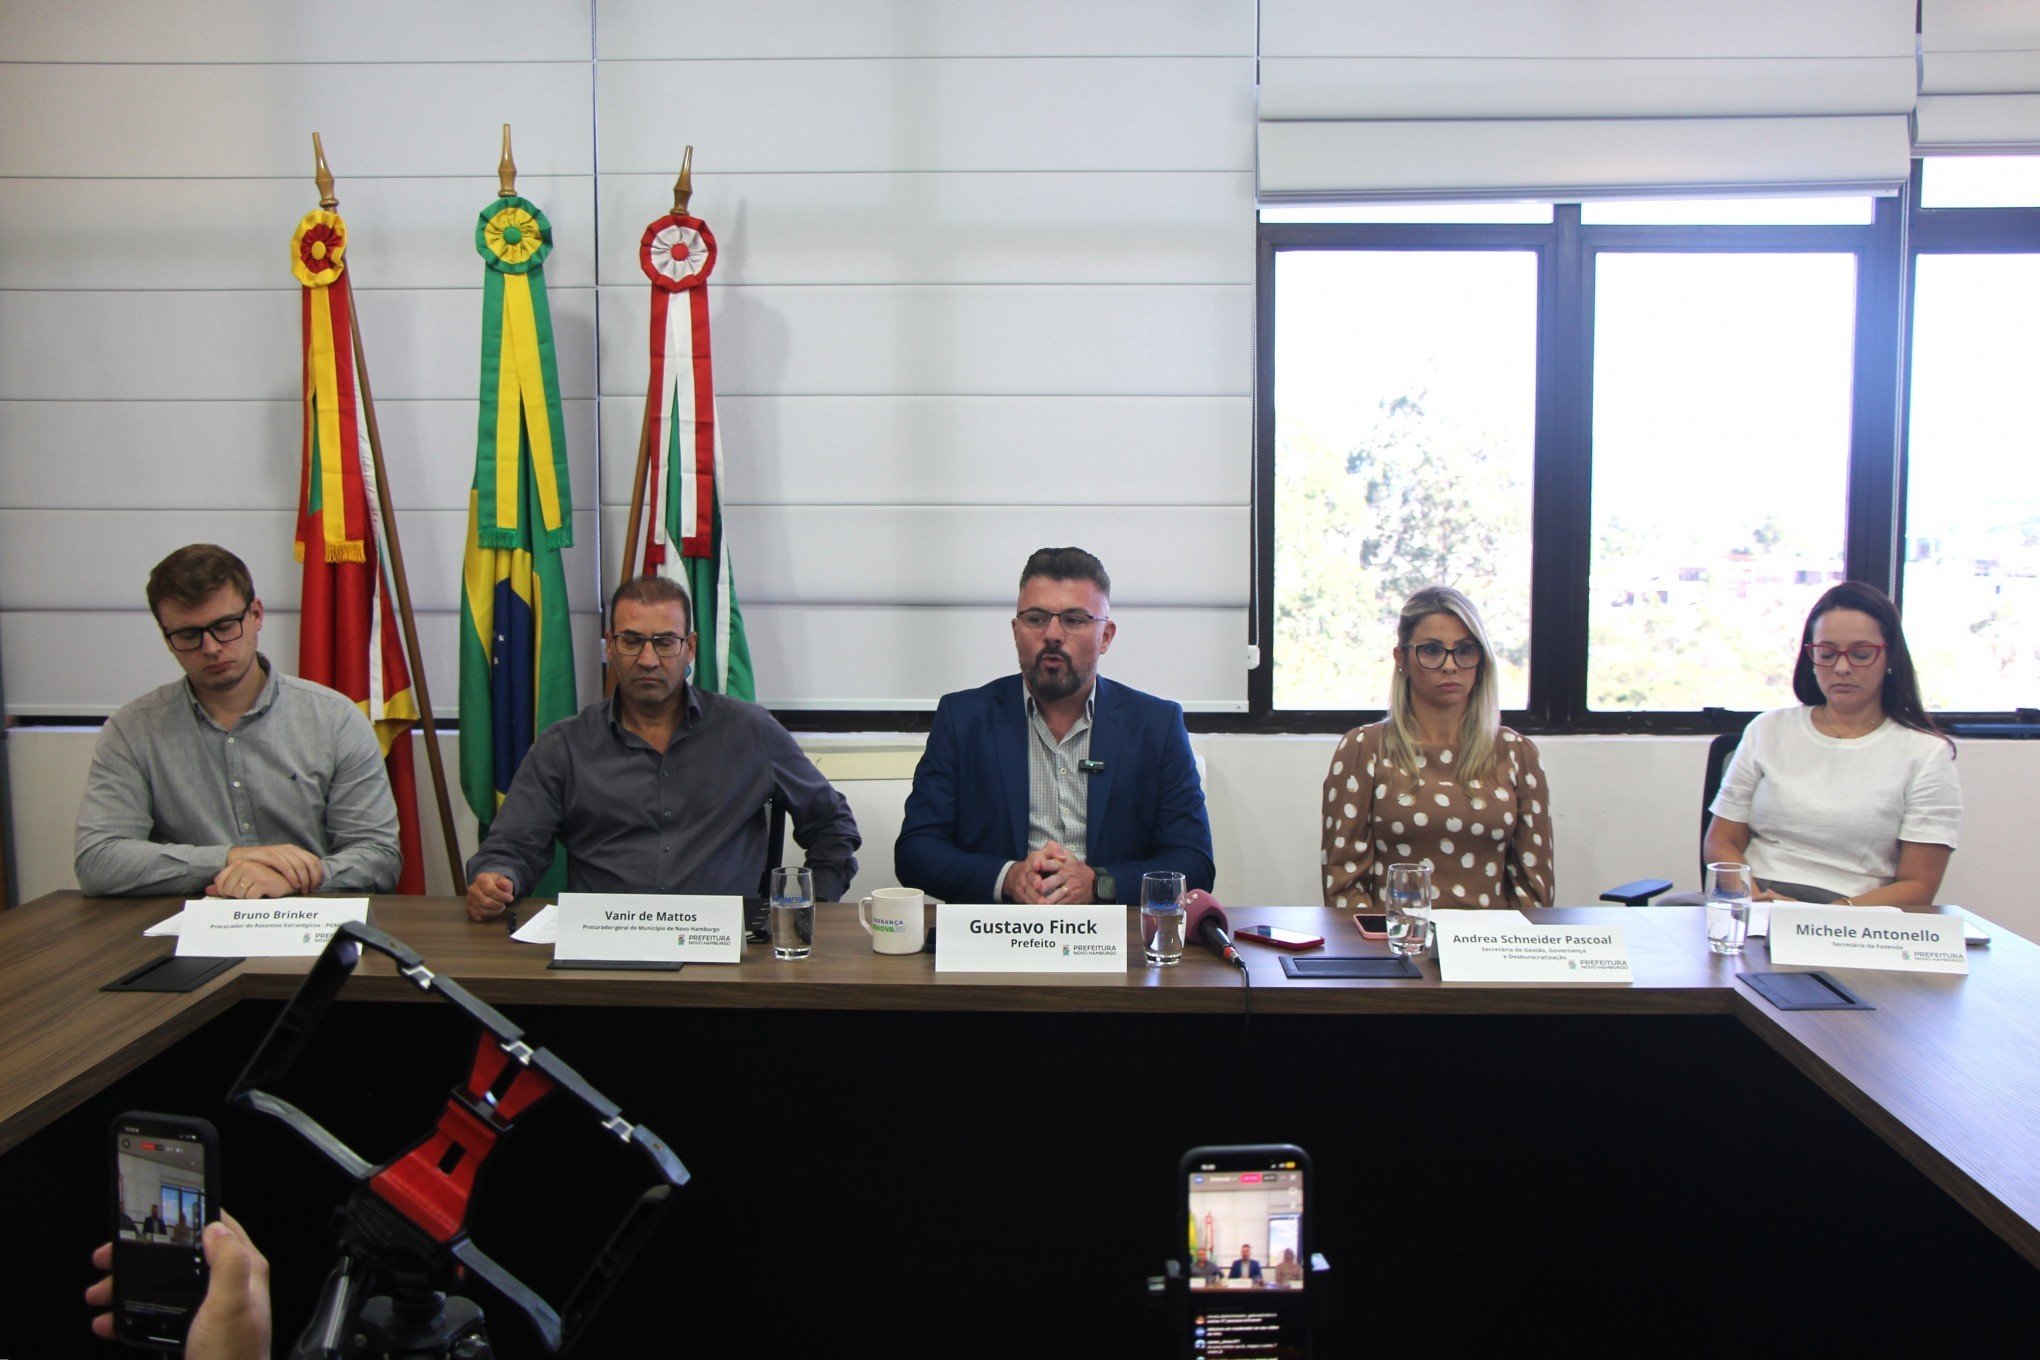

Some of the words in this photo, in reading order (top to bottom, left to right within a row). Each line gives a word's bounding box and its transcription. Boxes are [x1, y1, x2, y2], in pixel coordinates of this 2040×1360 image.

[233, 910, 270, 920] Bruno
[273, 910, 319, 920] Brinker
[605, 910, 637, 920] Vanir
[639, 910, 654, 921] de
[656, 911, 698, 922] Mattos
[969, 919, 1044, 935] Gustavo
[1050, 919, 1098, 935] Finck
[688, 934, 731, 942] PREFEITURA
[1796, 923, 1857, 938] Michele
[1861, 927, 1940, 943] Antonello
[1010, 938, 1056, 949] Prefeito
[1452, 934, 1498, 944] Andrea
[1500, 934, 1562, 945] Schneider
[1565, 935, 1612, 945] Pascoal
[1548, 947, 1587, 955] Governança
[1914, 951, 1964, 959] PREFEITURA
